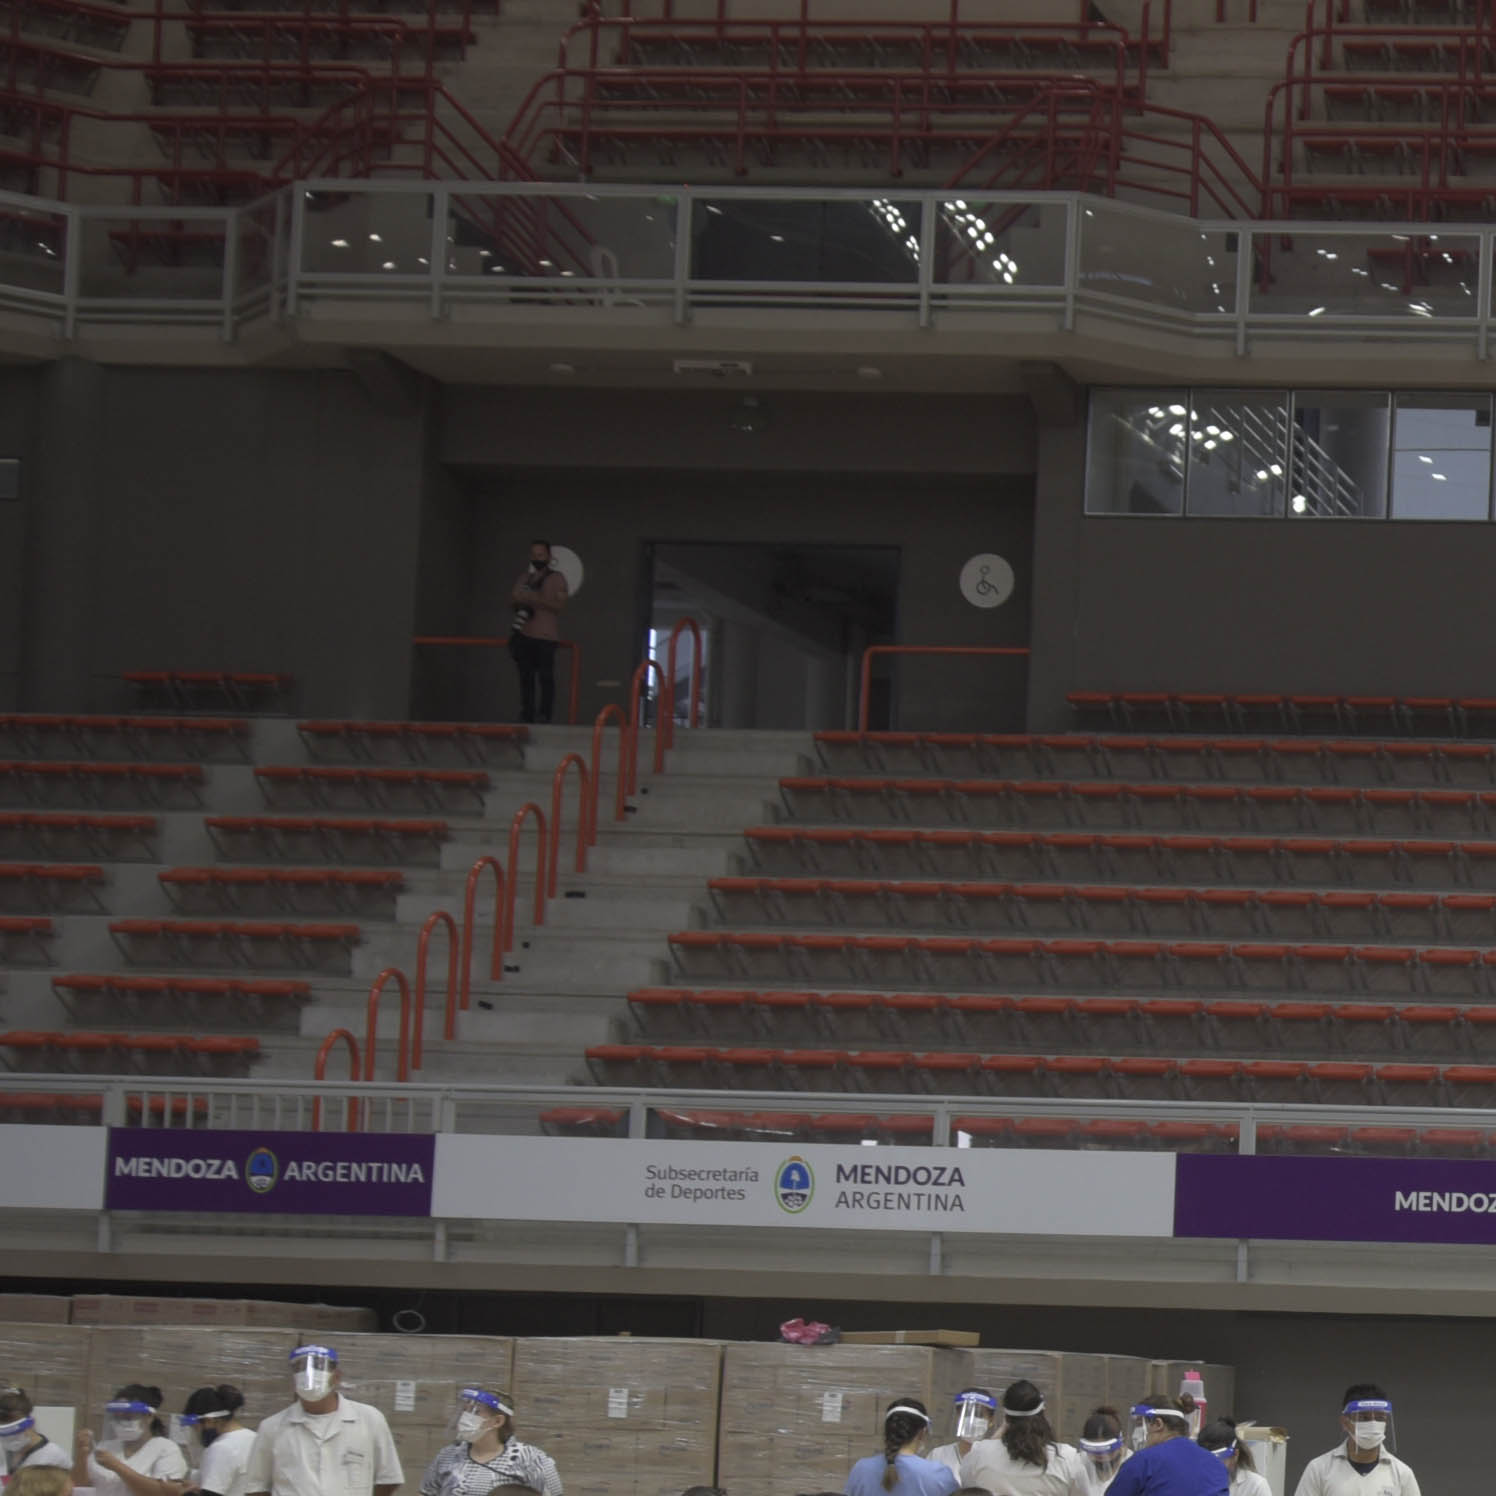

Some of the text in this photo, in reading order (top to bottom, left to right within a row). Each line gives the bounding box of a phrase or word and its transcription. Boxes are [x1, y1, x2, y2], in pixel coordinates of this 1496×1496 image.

[115, 1157, 424, 1182] MENDOZA ARGENTINA
[645, 1164, 759, 1183] Subsecretaría
[836, 1163, 966, 1186] MENDOZA
[645, 1183, 745, 1202] de Deportes
[835, 1190, 965, 1212] ARGENTINA
